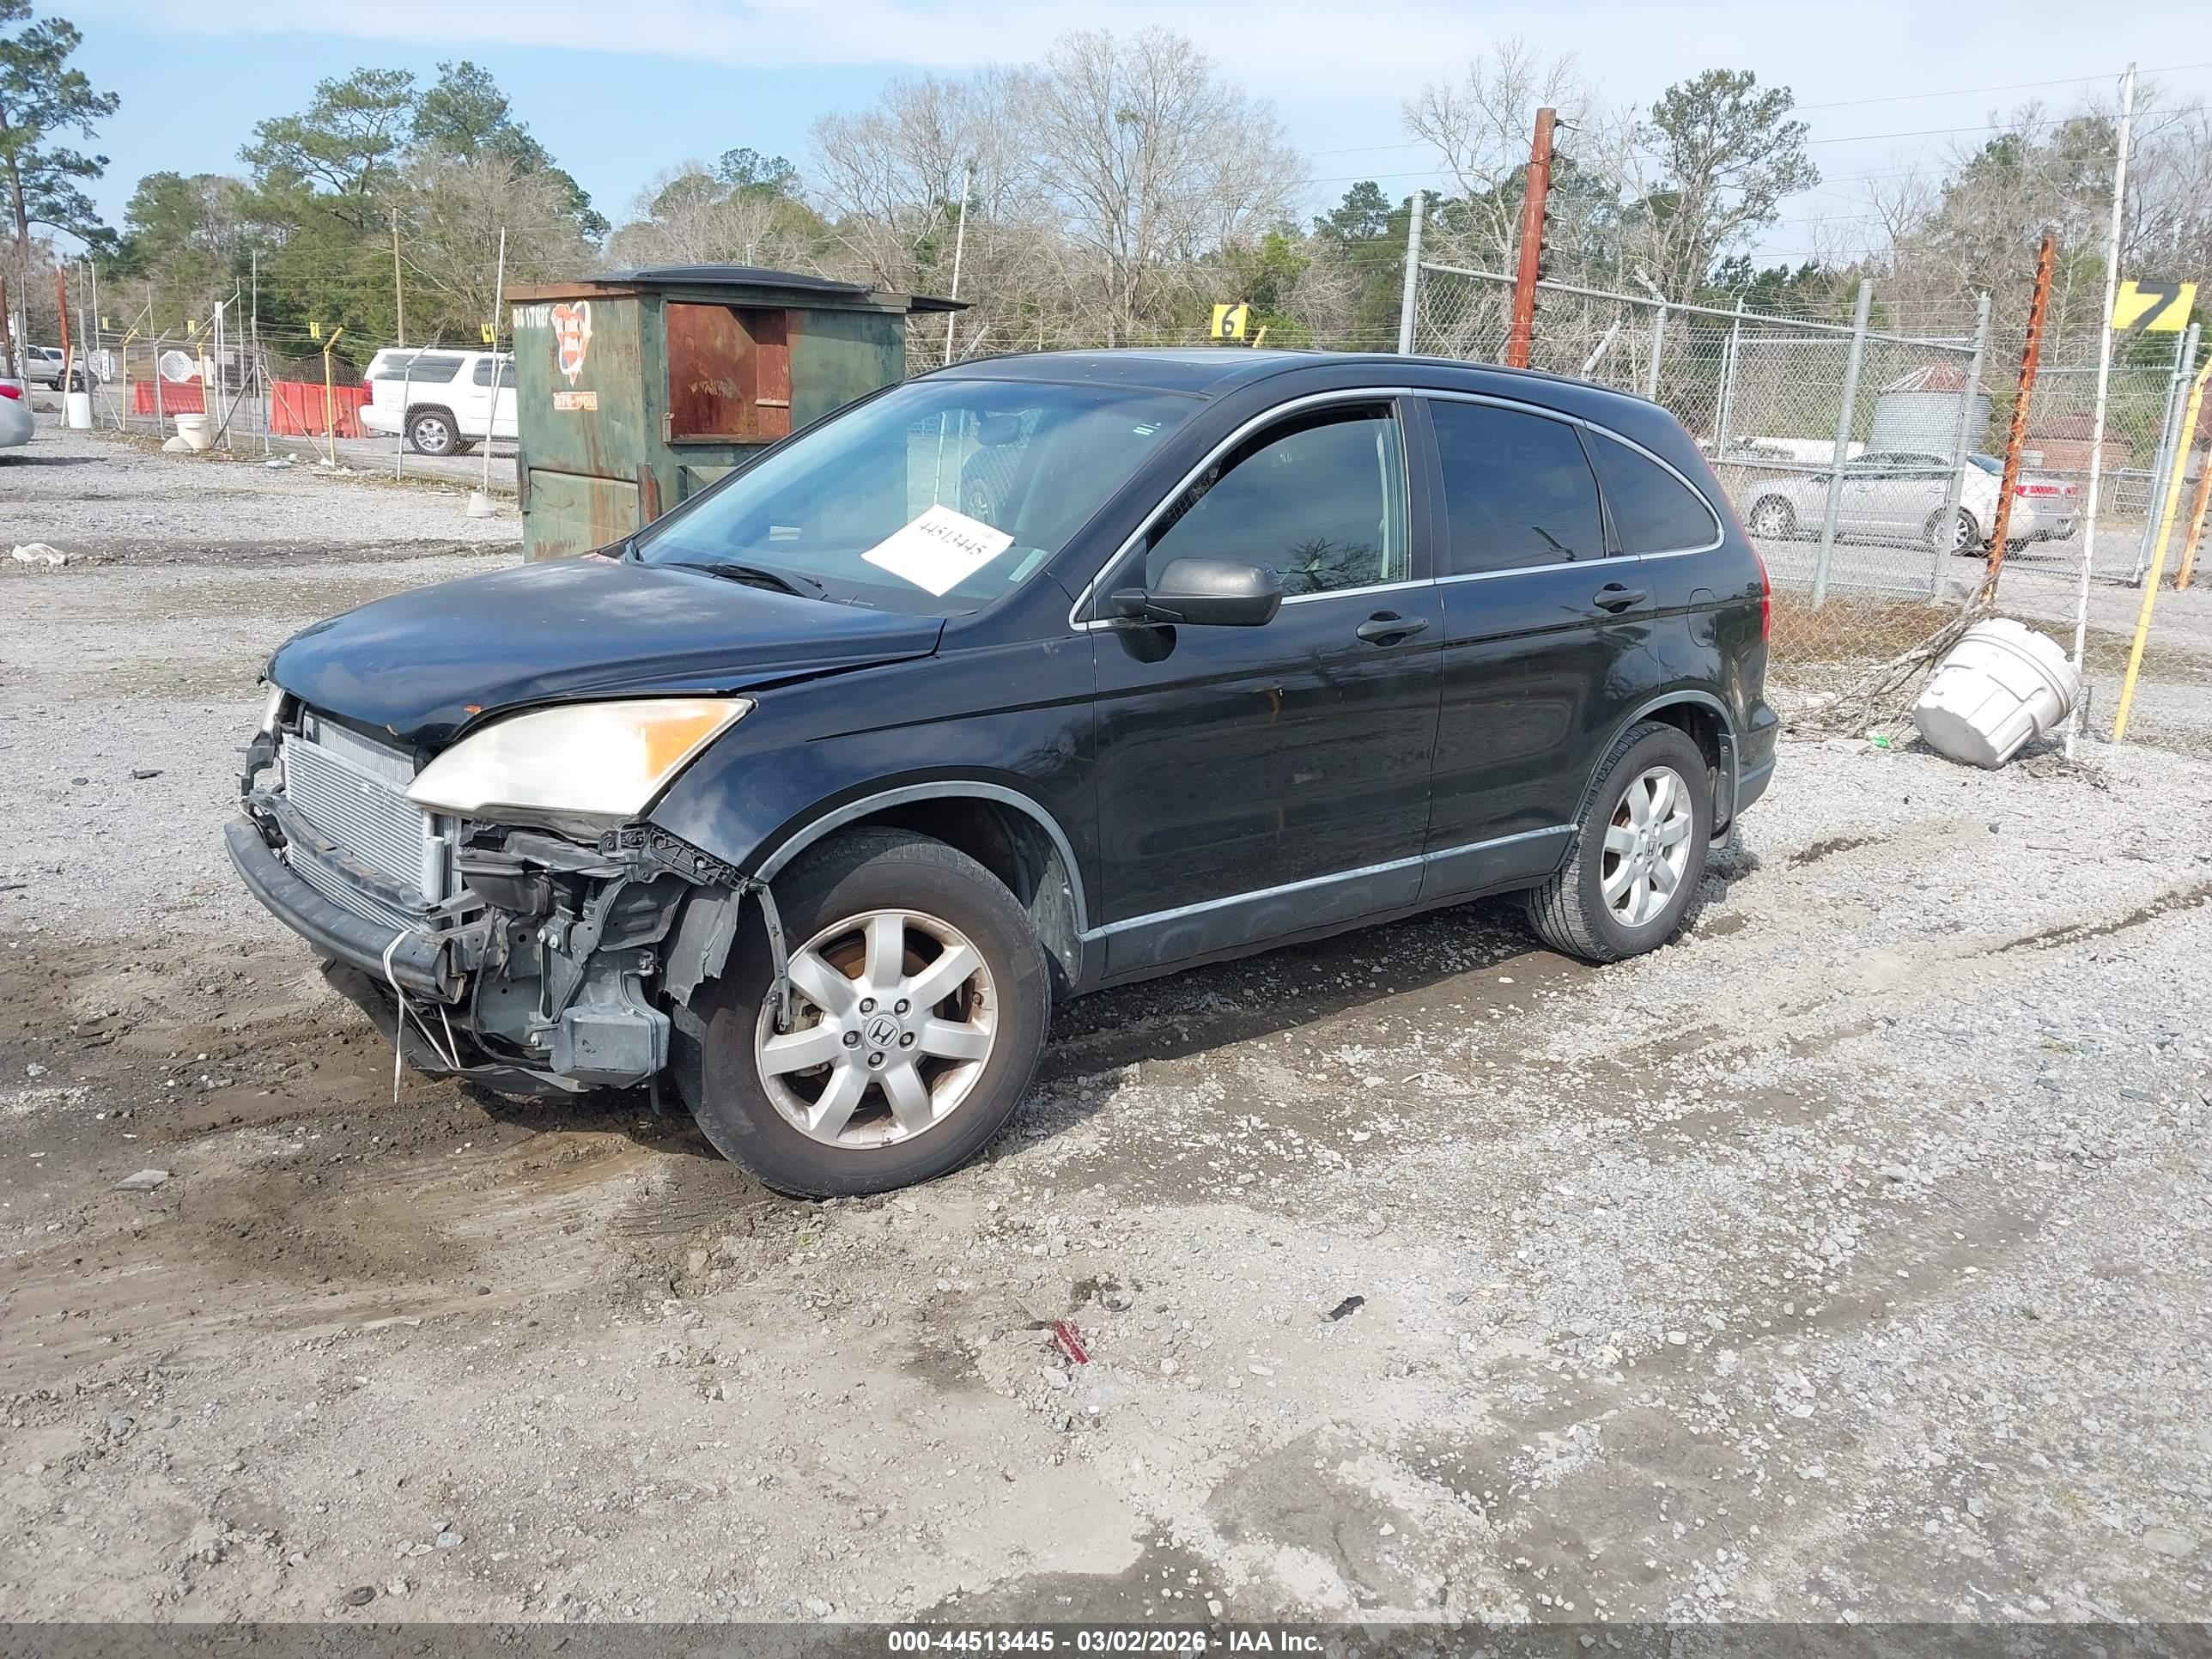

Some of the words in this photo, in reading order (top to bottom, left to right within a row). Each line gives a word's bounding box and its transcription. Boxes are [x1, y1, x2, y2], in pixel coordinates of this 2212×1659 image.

[1221, 301, 1240, 340] 6
[2133, 281, 2181, 330] 7
[483, 323, 493, 343] 4
[919, 521, 988, 556] 44513445
